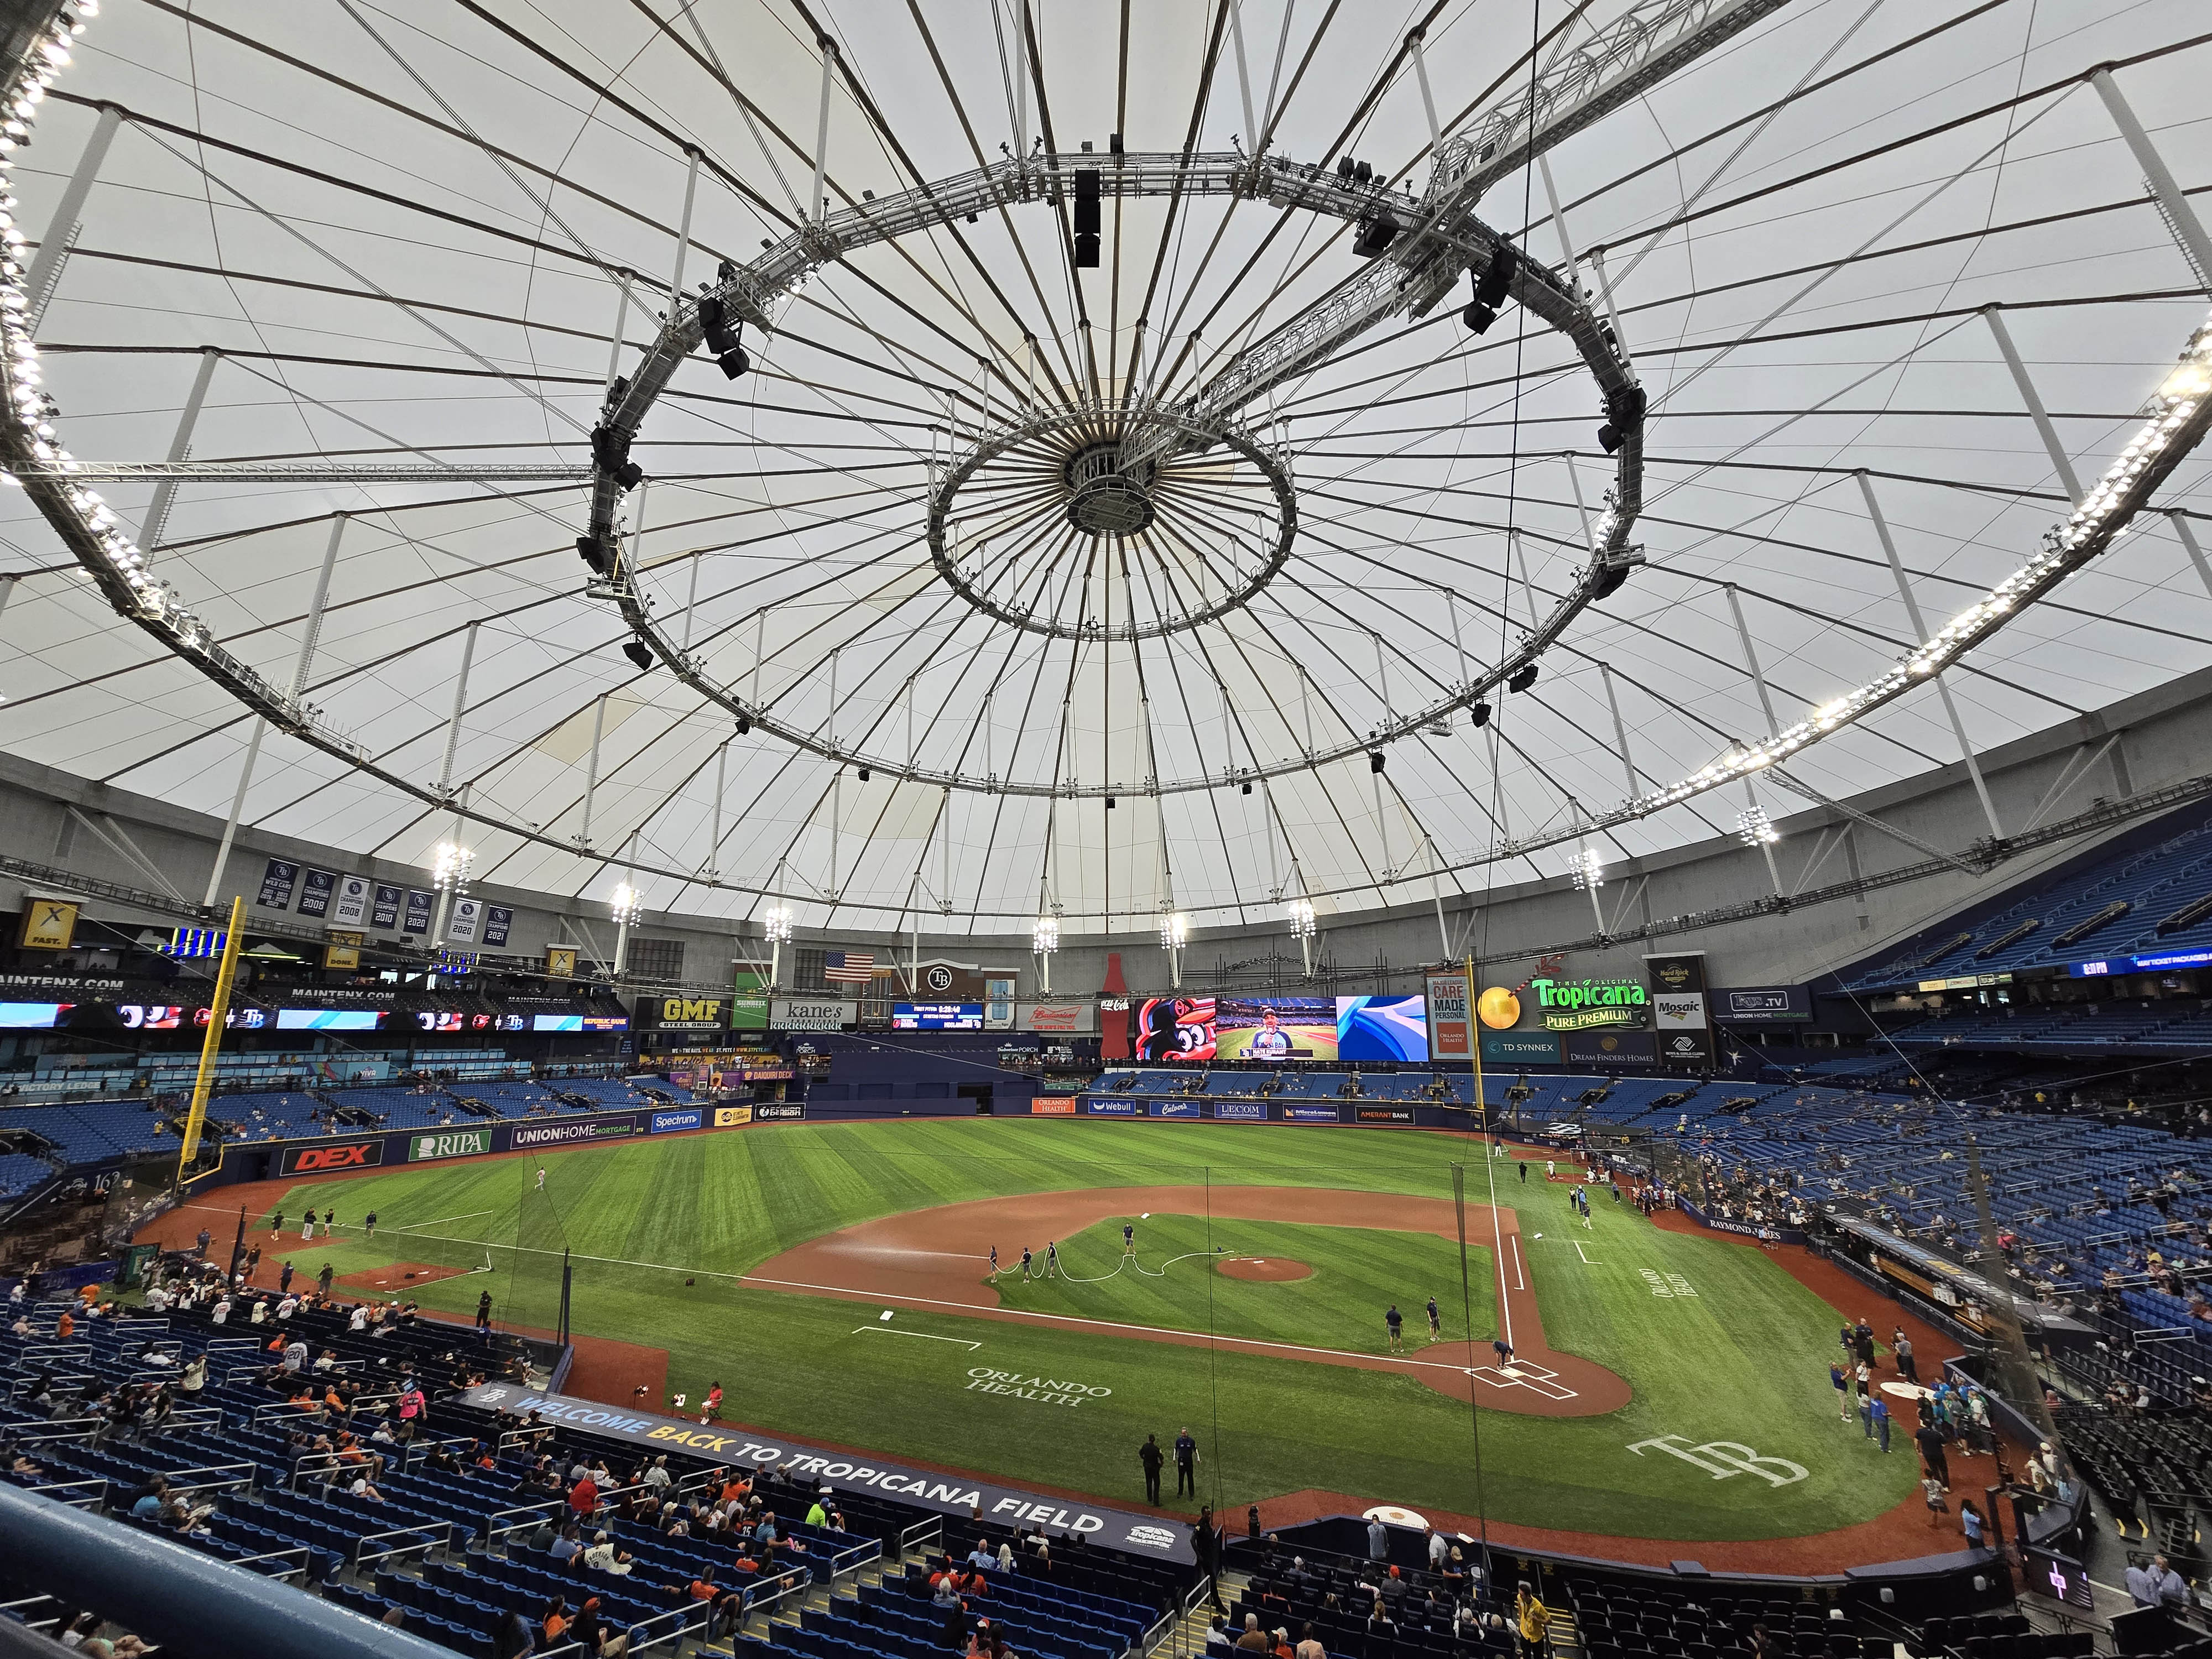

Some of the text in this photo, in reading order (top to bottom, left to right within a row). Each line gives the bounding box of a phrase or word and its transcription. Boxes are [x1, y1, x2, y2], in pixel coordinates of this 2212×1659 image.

[265, 878, 278, 886] WILD
[304, 889, 329, 899] CHAMPIONS
[302, 898, 325, 910] 2008
[339, 905, 360, 917] 2008
[375, 912, 393, 923] 2010
[407, 917, 426, 927] 2020
[452, 925, 472, 935] 2020
[488, 931, 504, 941] 2021
[2152, 958, 2172, 966] TICKET
[2172, 953, 2208, 963] PACKAGES
[932, 971, 948, 986] TB
[1433, 985, 1464, 999] CARE
[1531, 979, 1645, 1009] Tropicana
[664, 999, 721, 1021] GMF
[786, 1002, 843, 1019] kane's
[1434, 999, 1465, 1011] MADE
[1658, 1000, 1700, 1012] Mosaic
[1035, 1010, 1077, 1019] Budweiser
[1546, 1010, 1632, 1028] PURE PREMIUM
[1571, 1053, 1654, 1062] DREAM FINDERS HOMES
[754, 1070, 794, 1079] DAIQUIRI DECK
[18, 1082, 101, 1092] VICTORY LEDGE
[1106, 1102, 1131, 1111] Webull
[1162, 1102, 1188, 1114] Culver's
[656, 1115, 695, 1128] Spectrum
[517, 1124, 631, 1144] UNION HOME MORTGAGE
[435, 1133, 483, 1156] RIPA
[294, 1145, 372, 1171] DEX
[1709, 1220, 1752, 1234] RAYMOND
[287, 1350, 300, 1360] 20
[967, 1368, 1112, 1397] ORLANDO
[964, 1379, 1085, 1407] HEALTH
[514, 1396, 1104, 1533] WELCOME BACK TO TROPICANA FIELD
[1625, 1434, 1810, 1488] TB
[1130, 1527, 1175, 1543] Tropicana
